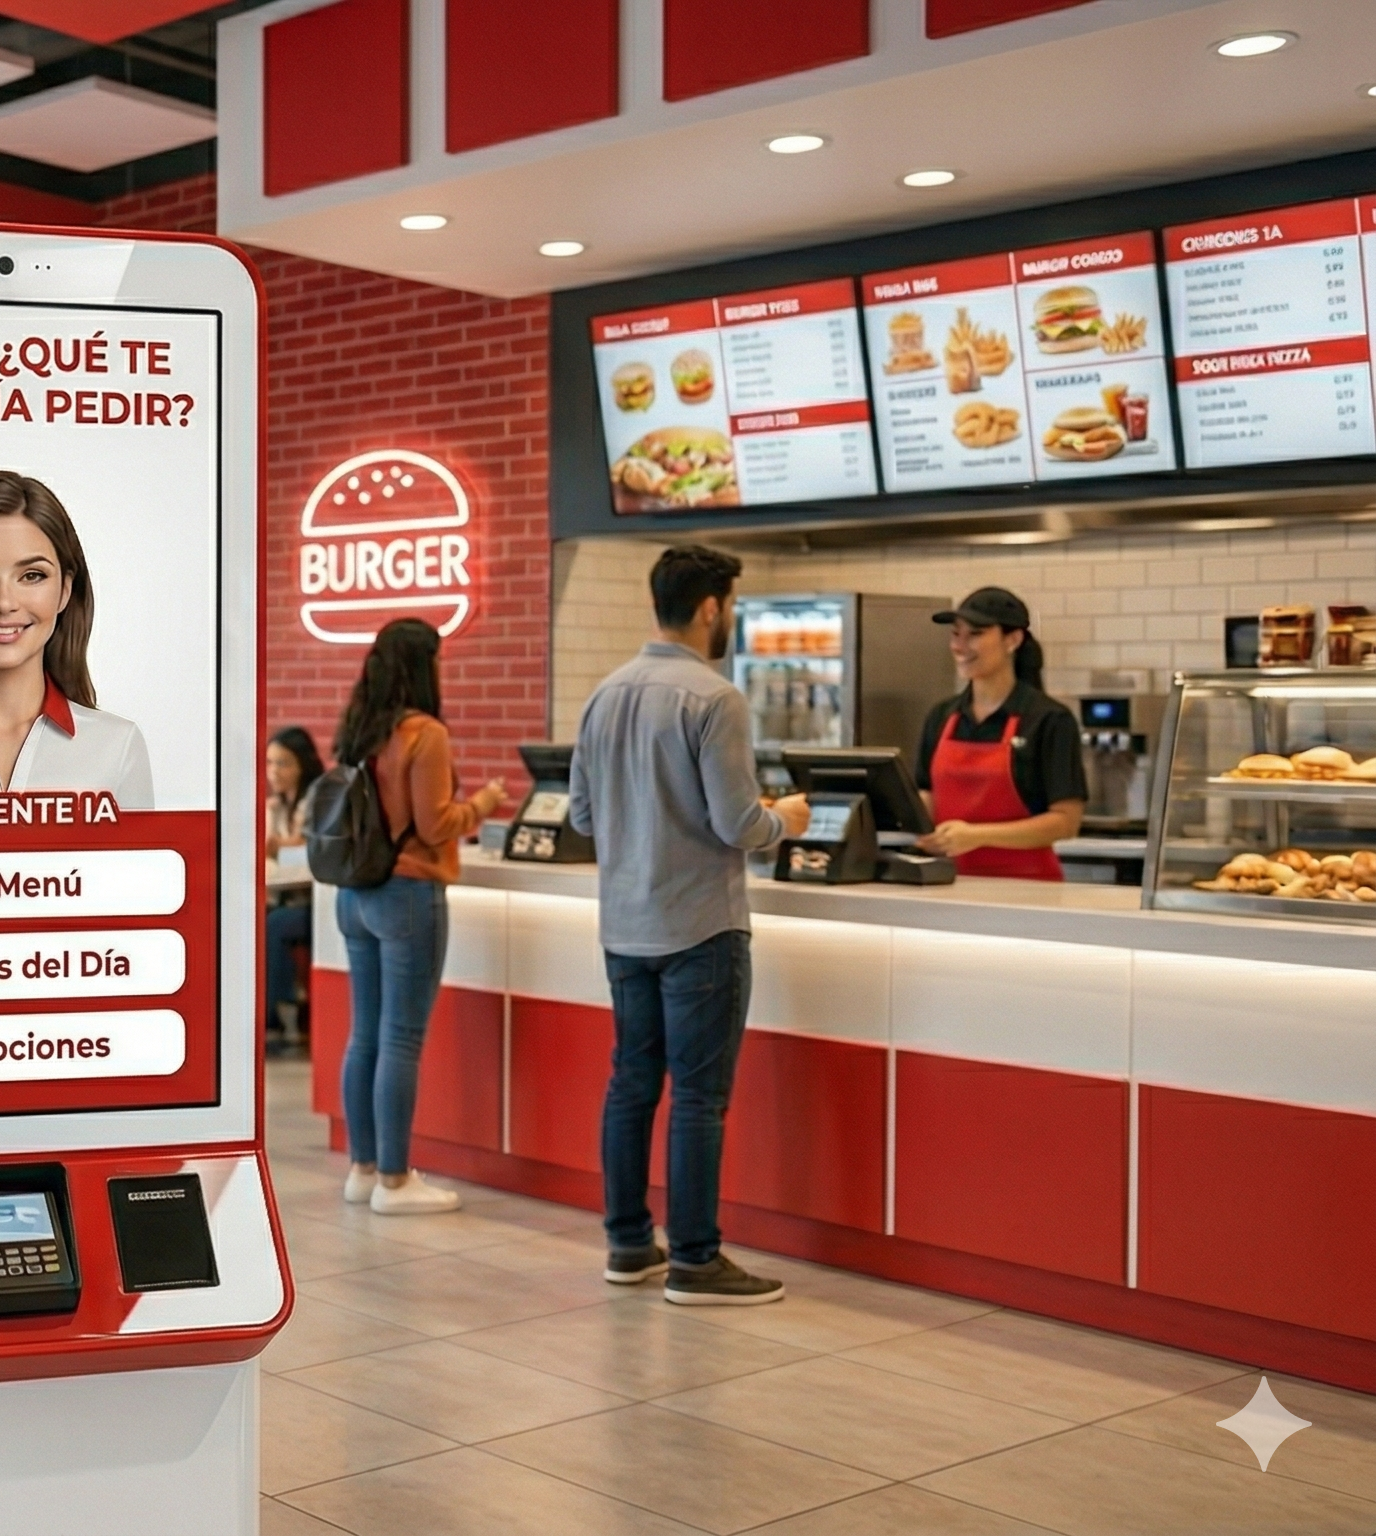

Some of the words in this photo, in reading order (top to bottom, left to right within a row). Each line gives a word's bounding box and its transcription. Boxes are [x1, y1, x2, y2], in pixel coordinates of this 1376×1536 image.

[120, 340, 172, 376] TE
[45, 390, 195, 427] PEDIR?
[300, 535, 471, 595] BURGER
[85, 797, 118, 824] IA
[21, 950, 69, 979] del
[80, 948, 130, 977] Día
